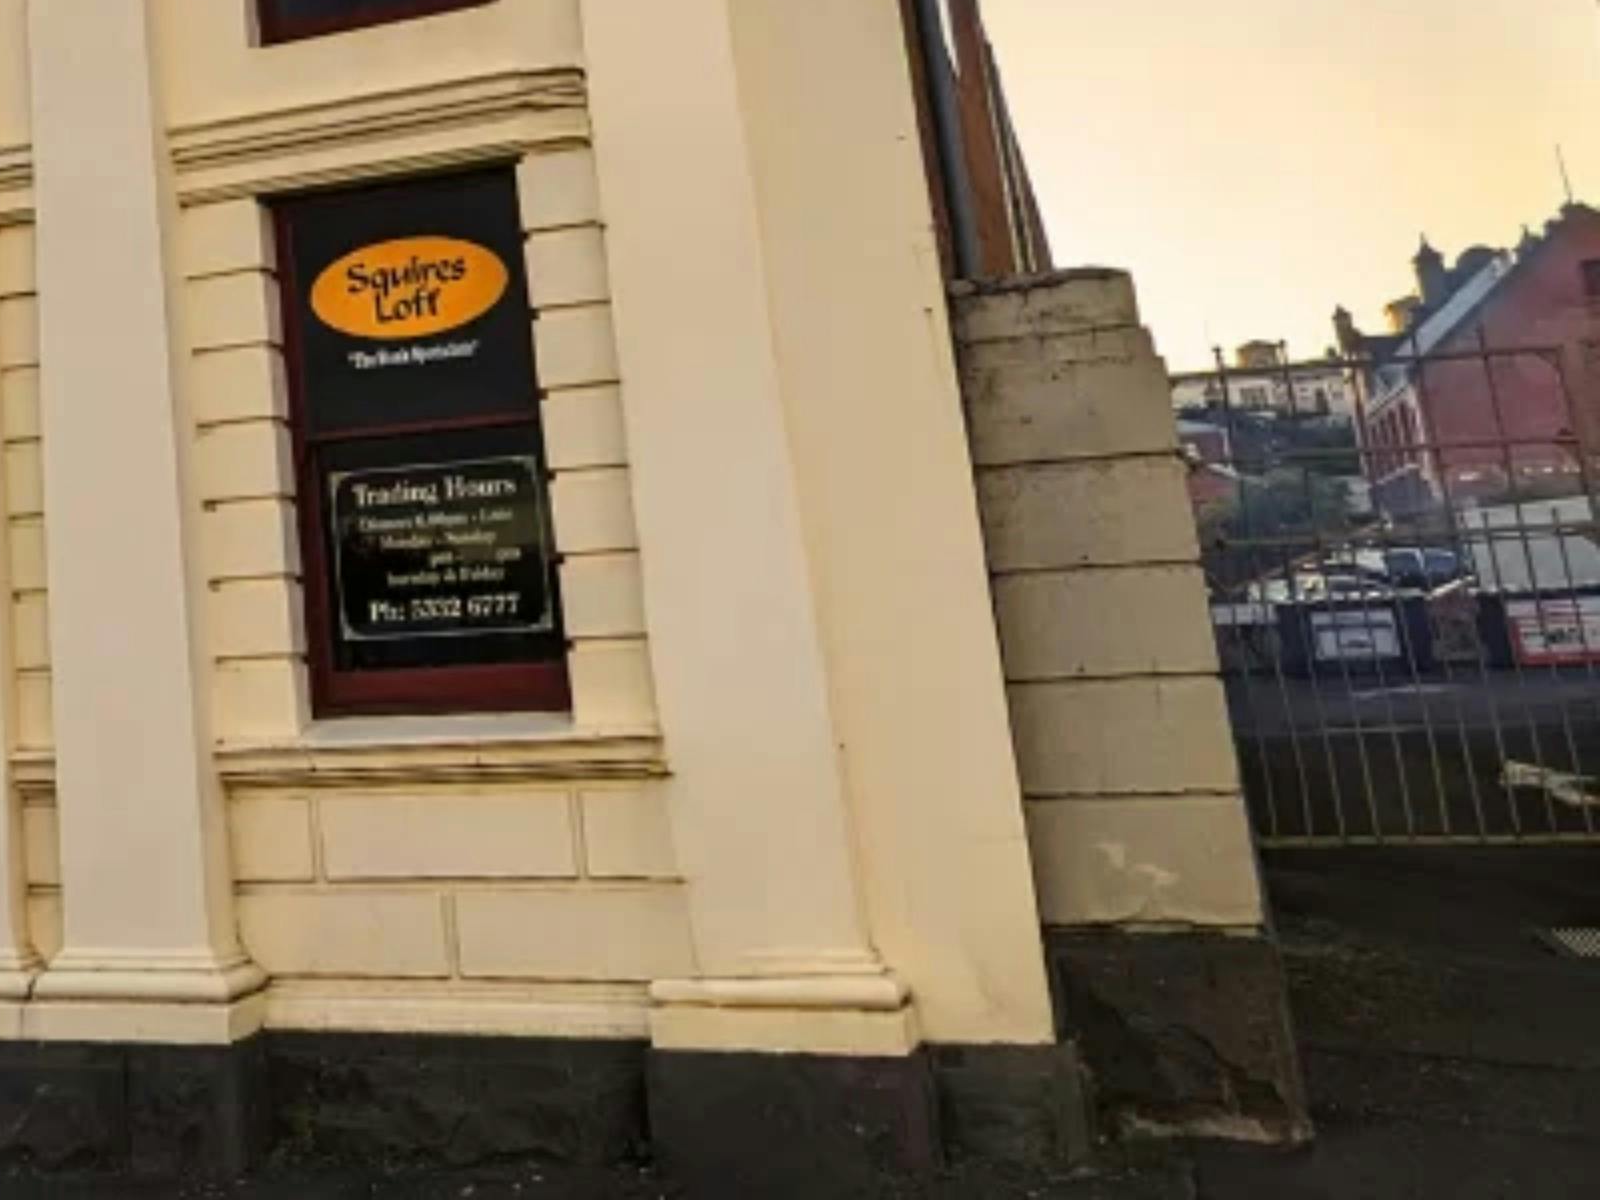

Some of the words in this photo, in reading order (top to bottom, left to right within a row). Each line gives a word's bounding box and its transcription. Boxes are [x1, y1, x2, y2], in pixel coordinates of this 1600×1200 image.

[346, 254, 467, 297] Squires
[374, 287, 441, 325] Loft
[352, 480, 439, 506] Trading
[443, 475, 517, 499] Hours
